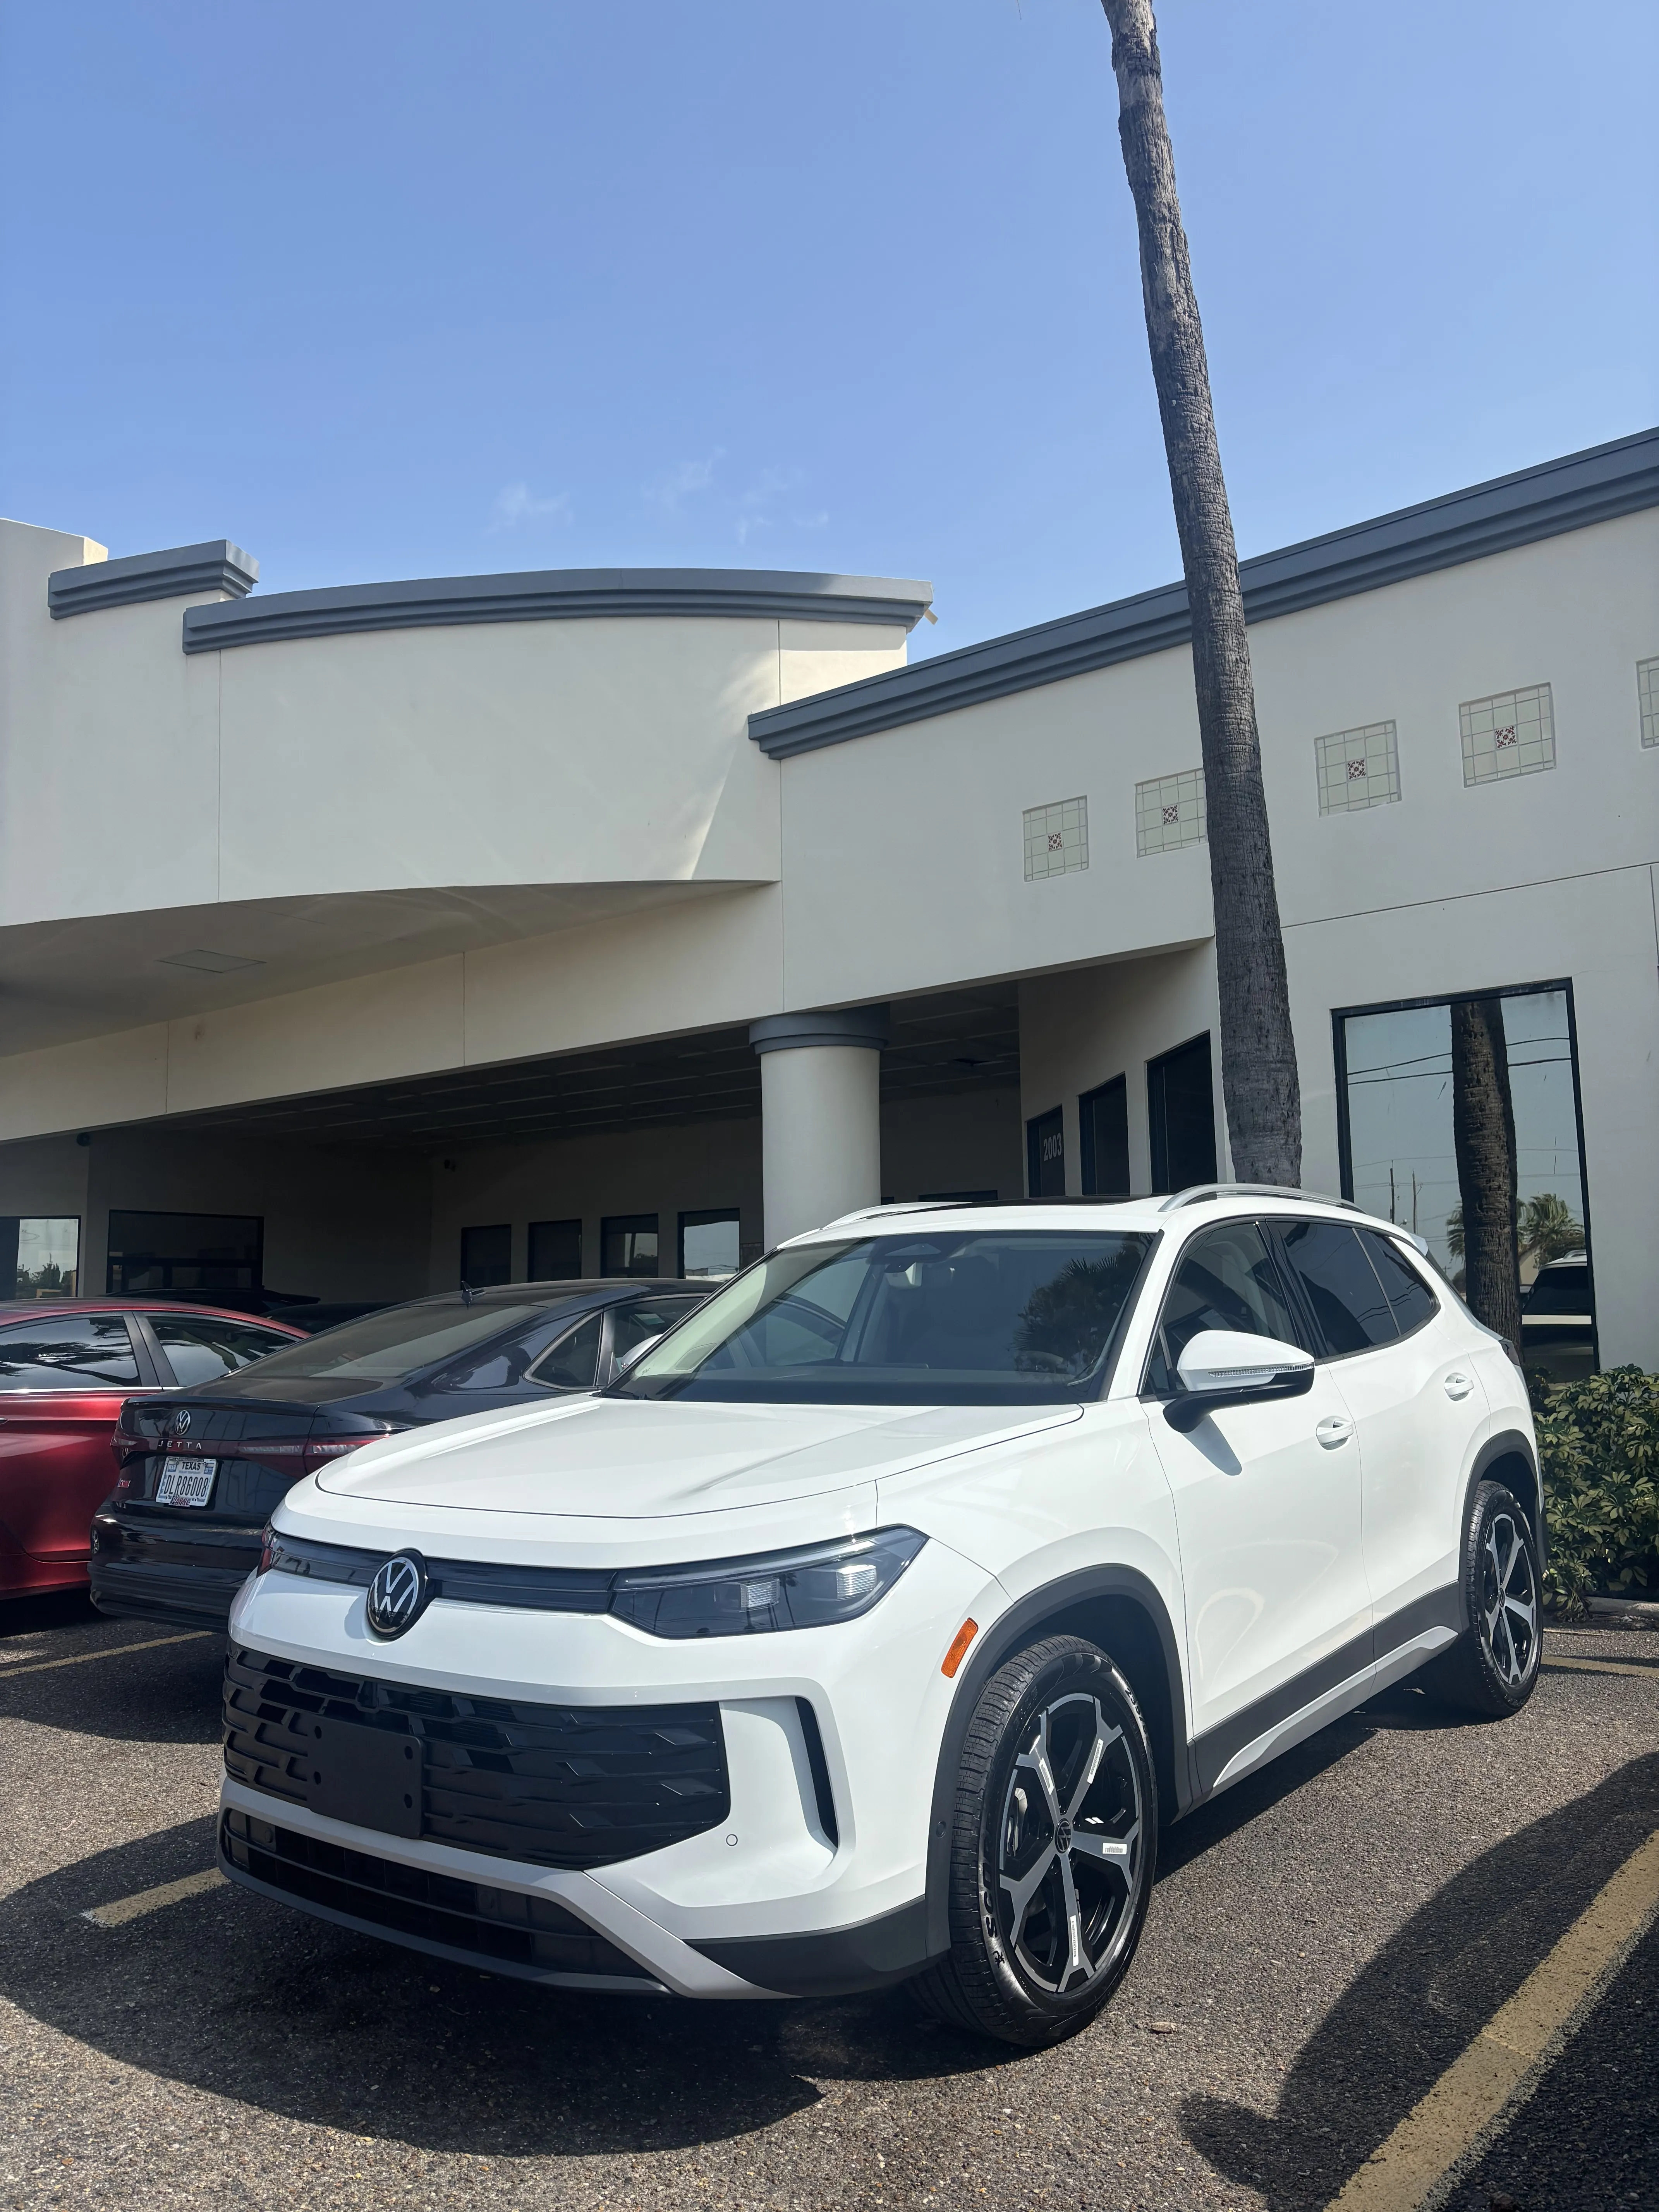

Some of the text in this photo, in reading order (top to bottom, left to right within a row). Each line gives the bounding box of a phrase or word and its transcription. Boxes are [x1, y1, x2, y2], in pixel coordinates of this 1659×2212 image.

[1044, 1133, 1062, 1161] 2003
[158, 1441, 202, 1449] JETTA
[182, 1462, 201, 1471] TEXAS
[163, 1475, 209, 1498] DLR86008
[368, 1556, 419, 1633] VW
